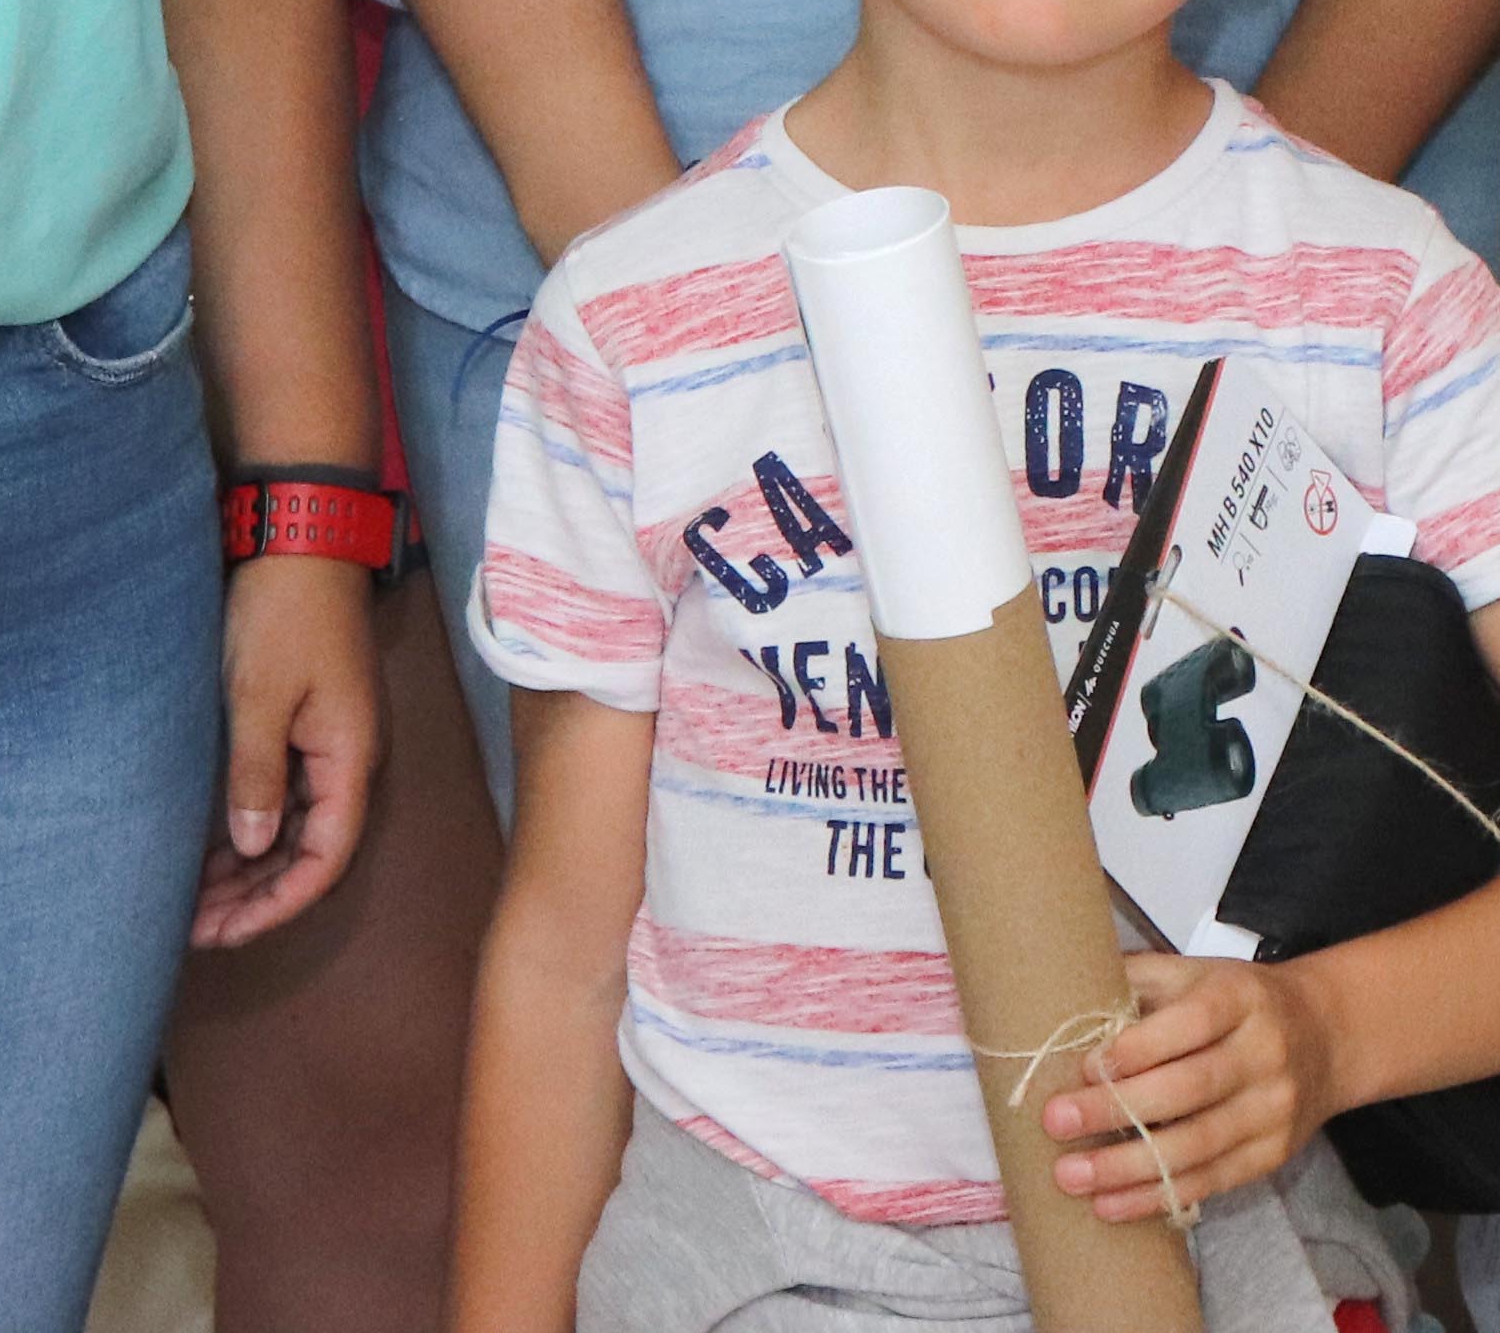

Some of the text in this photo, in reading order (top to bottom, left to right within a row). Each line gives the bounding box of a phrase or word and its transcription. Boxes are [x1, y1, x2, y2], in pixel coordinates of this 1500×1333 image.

[1230, 451, 1257, 500] 540
[1248, 406, 1275, 458] X10
[1092, 619, 1121, 675] QUECHUA
[765, 758, 908, 804] LIVING THE
[827, 819, 906, 880] THE
